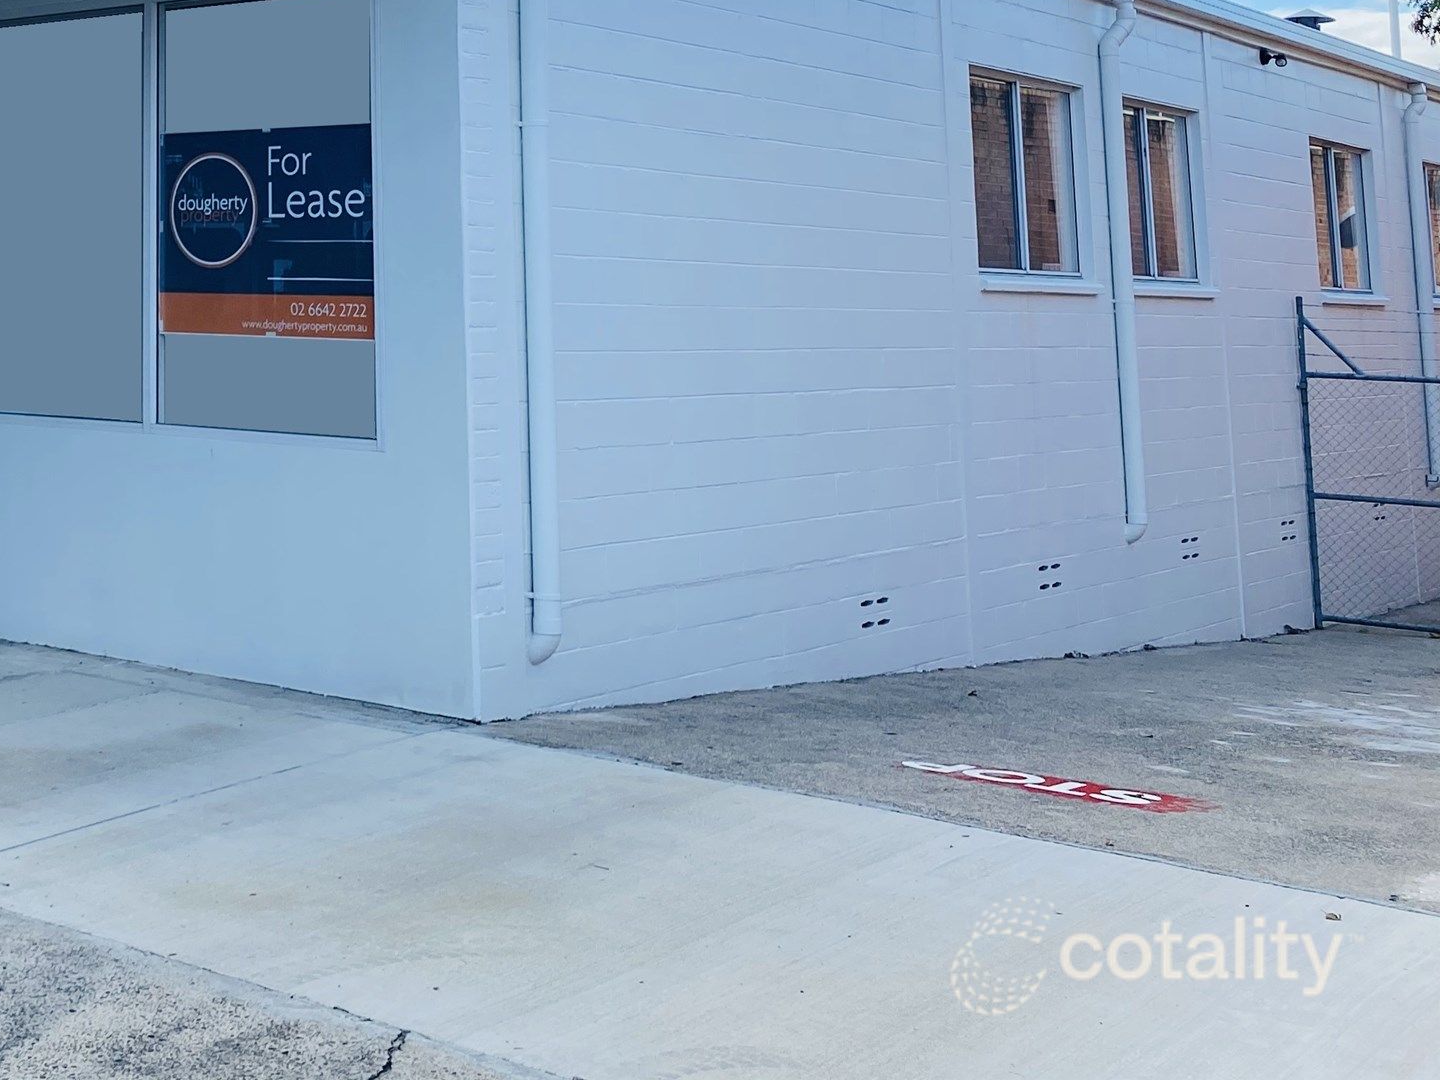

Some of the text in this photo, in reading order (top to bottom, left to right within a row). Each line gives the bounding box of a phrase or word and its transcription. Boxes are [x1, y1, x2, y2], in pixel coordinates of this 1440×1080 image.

[267, 145, 312, 176] For
[177, 193, 248, 215] dougherty
[267, 181, 365, 219] Lease
[180, 209, 240, 225] property
[290, 302, 367, 318] 02 6642 2722
[241, 319, 368, 333] www.doughertyproperty.com.au
[901, 760, 1162, 805] STOP
